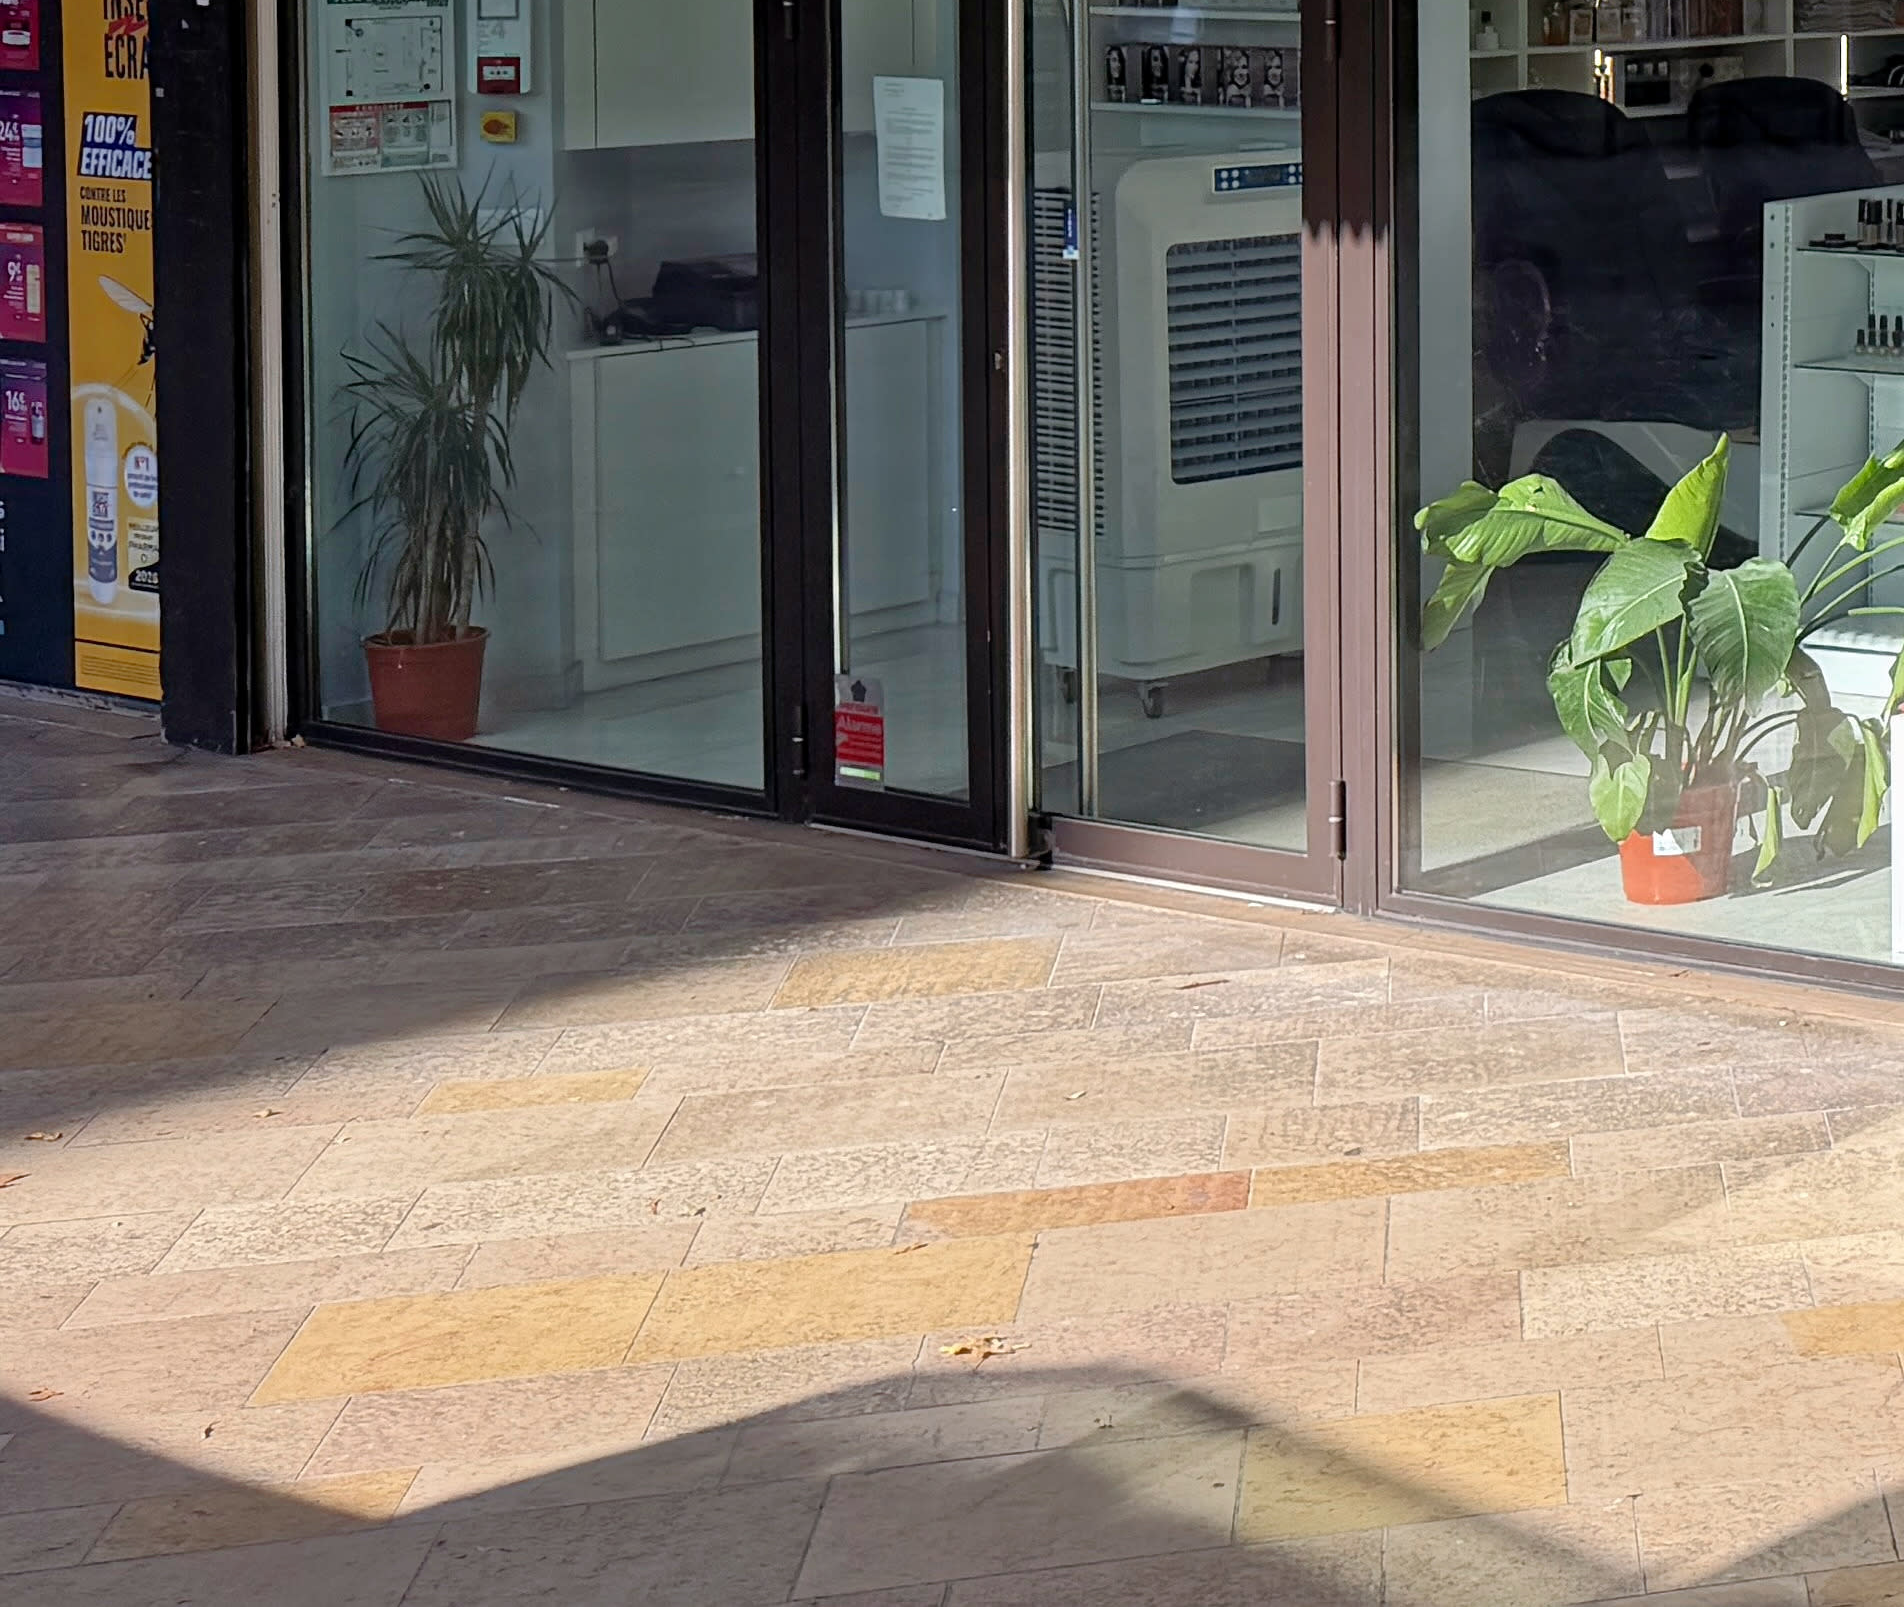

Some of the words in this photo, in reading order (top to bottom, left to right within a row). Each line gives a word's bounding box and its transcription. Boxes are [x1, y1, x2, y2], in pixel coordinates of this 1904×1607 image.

[84, 113, 136, 147] 100%
[80, 146, 152, 180] EFFICACE
[112, 188, 127, 204] LES
[80, 205, 153, 232] MOUSTIQUE
